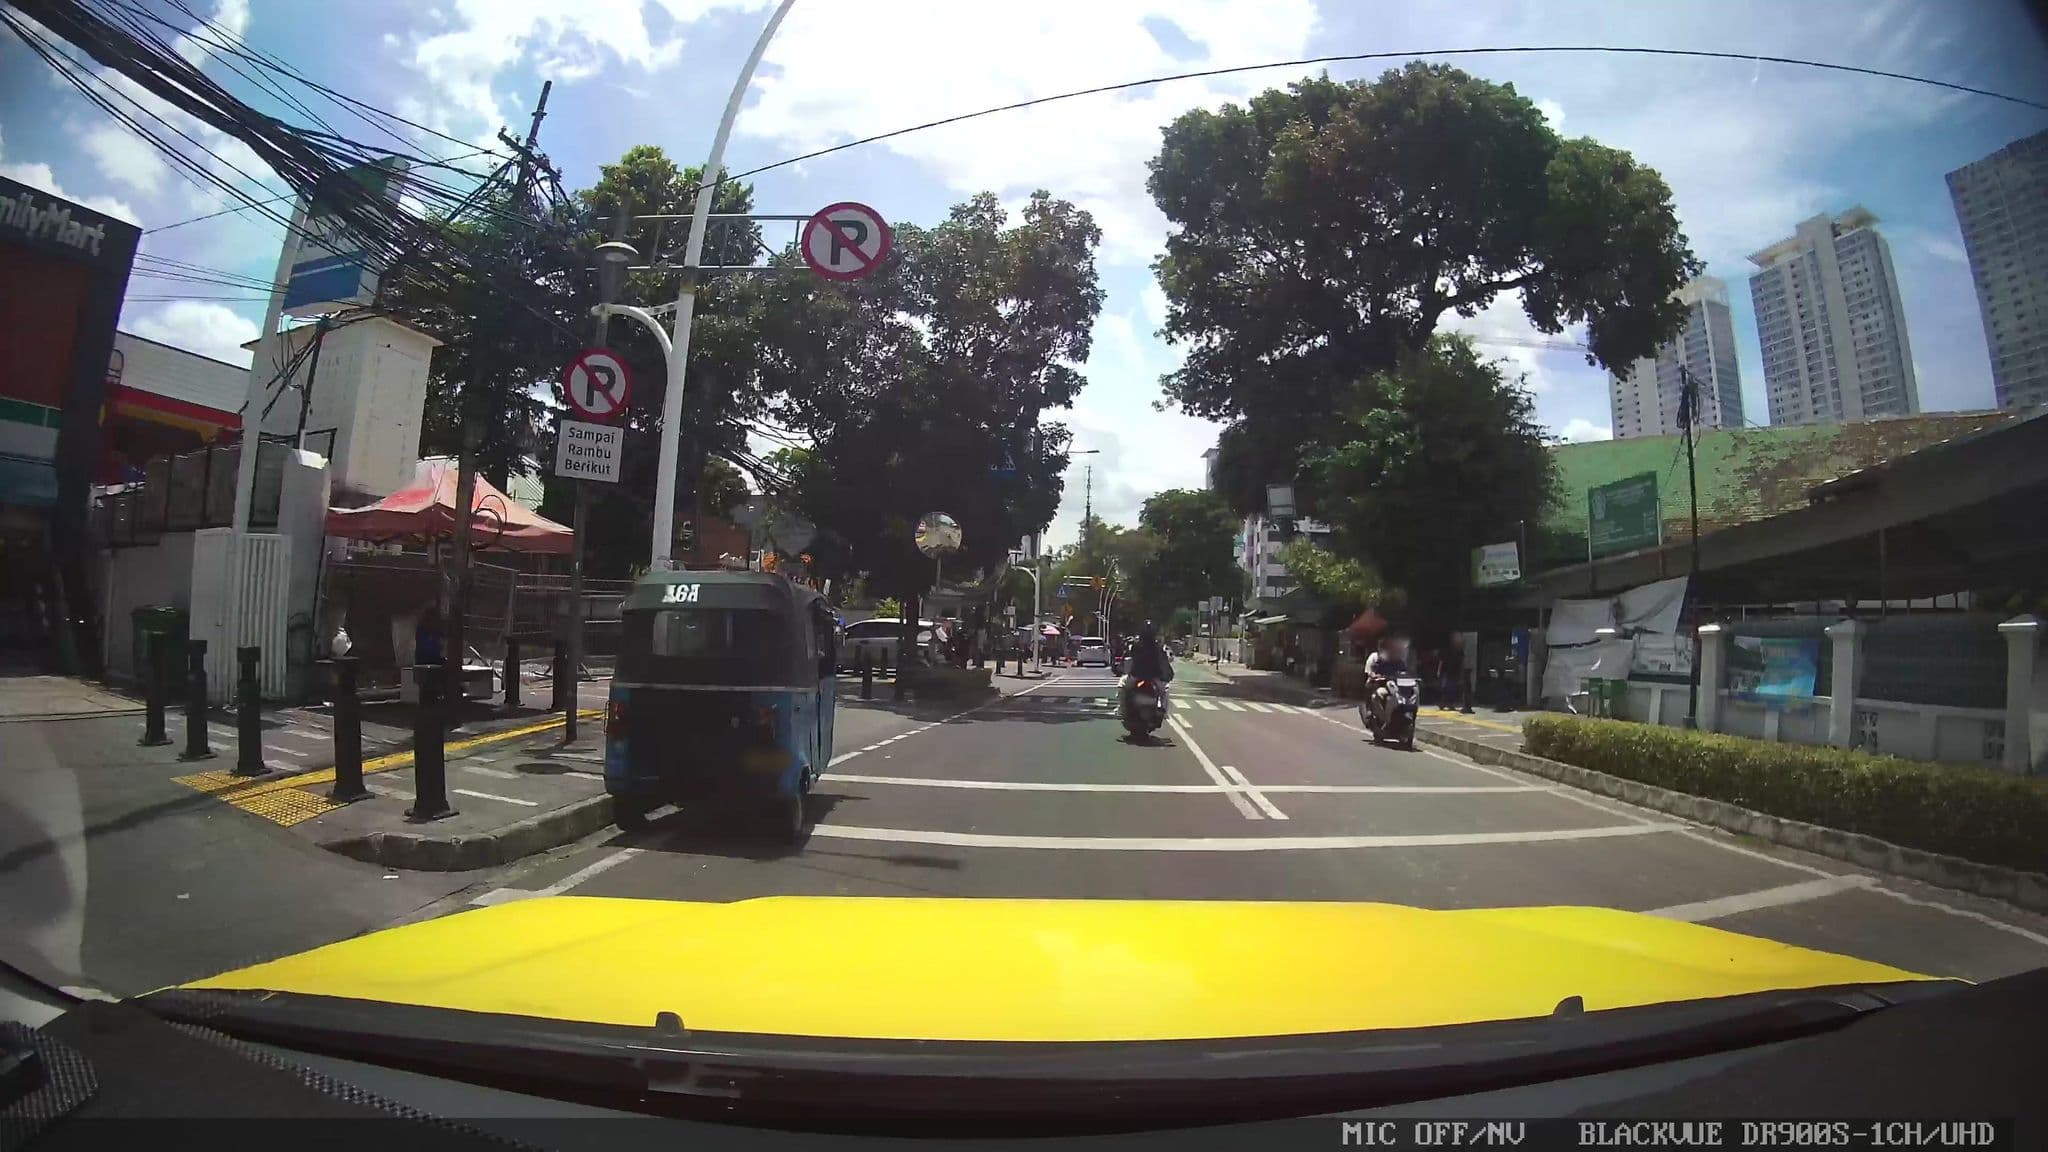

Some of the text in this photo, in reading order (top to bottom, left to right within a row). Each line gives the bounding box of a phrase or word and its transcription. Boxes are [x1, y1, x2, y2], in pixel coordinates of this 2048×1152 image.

[830, 220, 868, 265] P
[586, 365, 616, 407] P
[568, 427, 615, 445] Sampai
[568, 444, 612, 459] Rambu
[564, 459, 611, 475] Berikut
